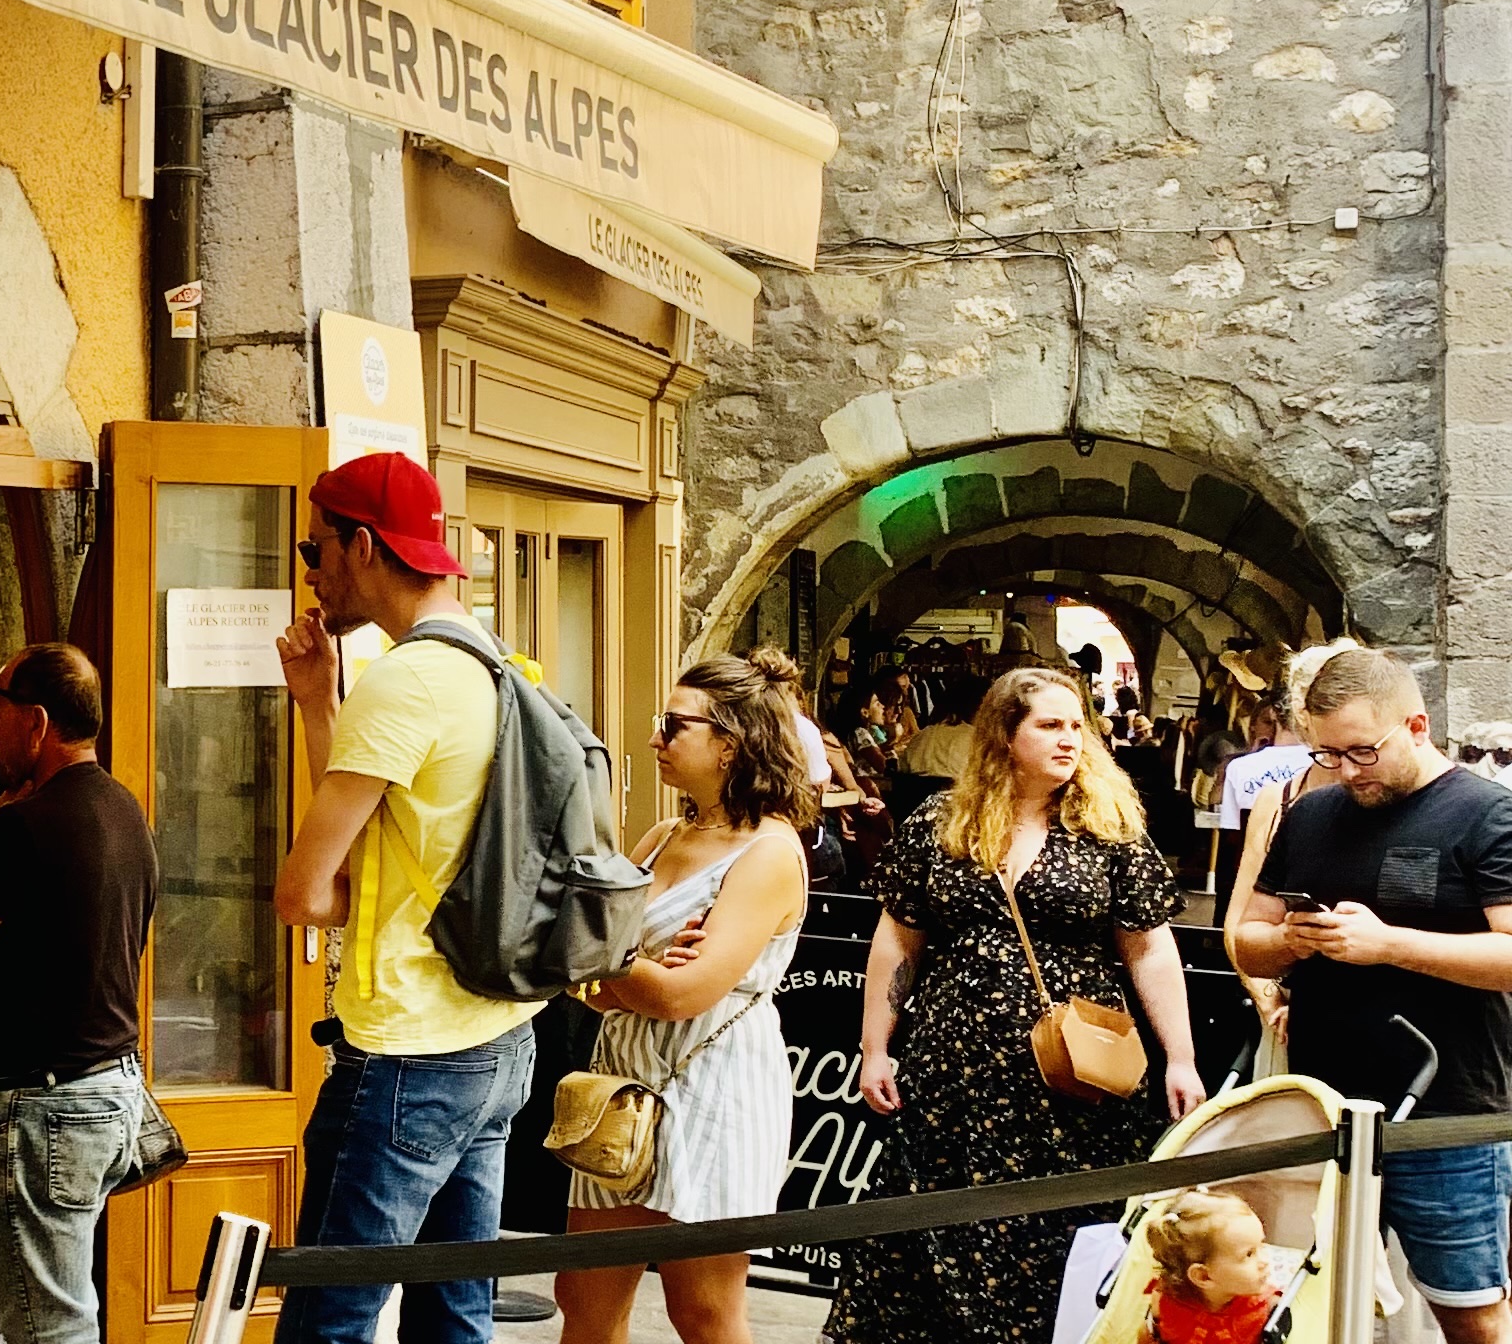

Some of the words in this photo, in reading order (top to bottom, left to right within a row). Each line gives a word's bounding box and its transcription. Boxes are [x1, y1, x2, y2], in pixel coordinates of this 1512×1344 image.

[432, 27, 512, 134] DES
[524, 70, 639, 180] ALPES
[588, 213, 604, 257] LE
[605, 223, 651, 281] GLACIER
[651, 250, 673, 294] DES
[673, 263, 705, 310] ALPES
[186, 604, 199, 614] LE
[200, 603, 246, 614] GLACIER
[248, 603, 270, 614] DES
[187, 617, 219, 627] ALPES
[220, 617, 270, 627] RECRUTE
[772, 969, 817, 997] CES
[822, 969, 867, 990] ART
